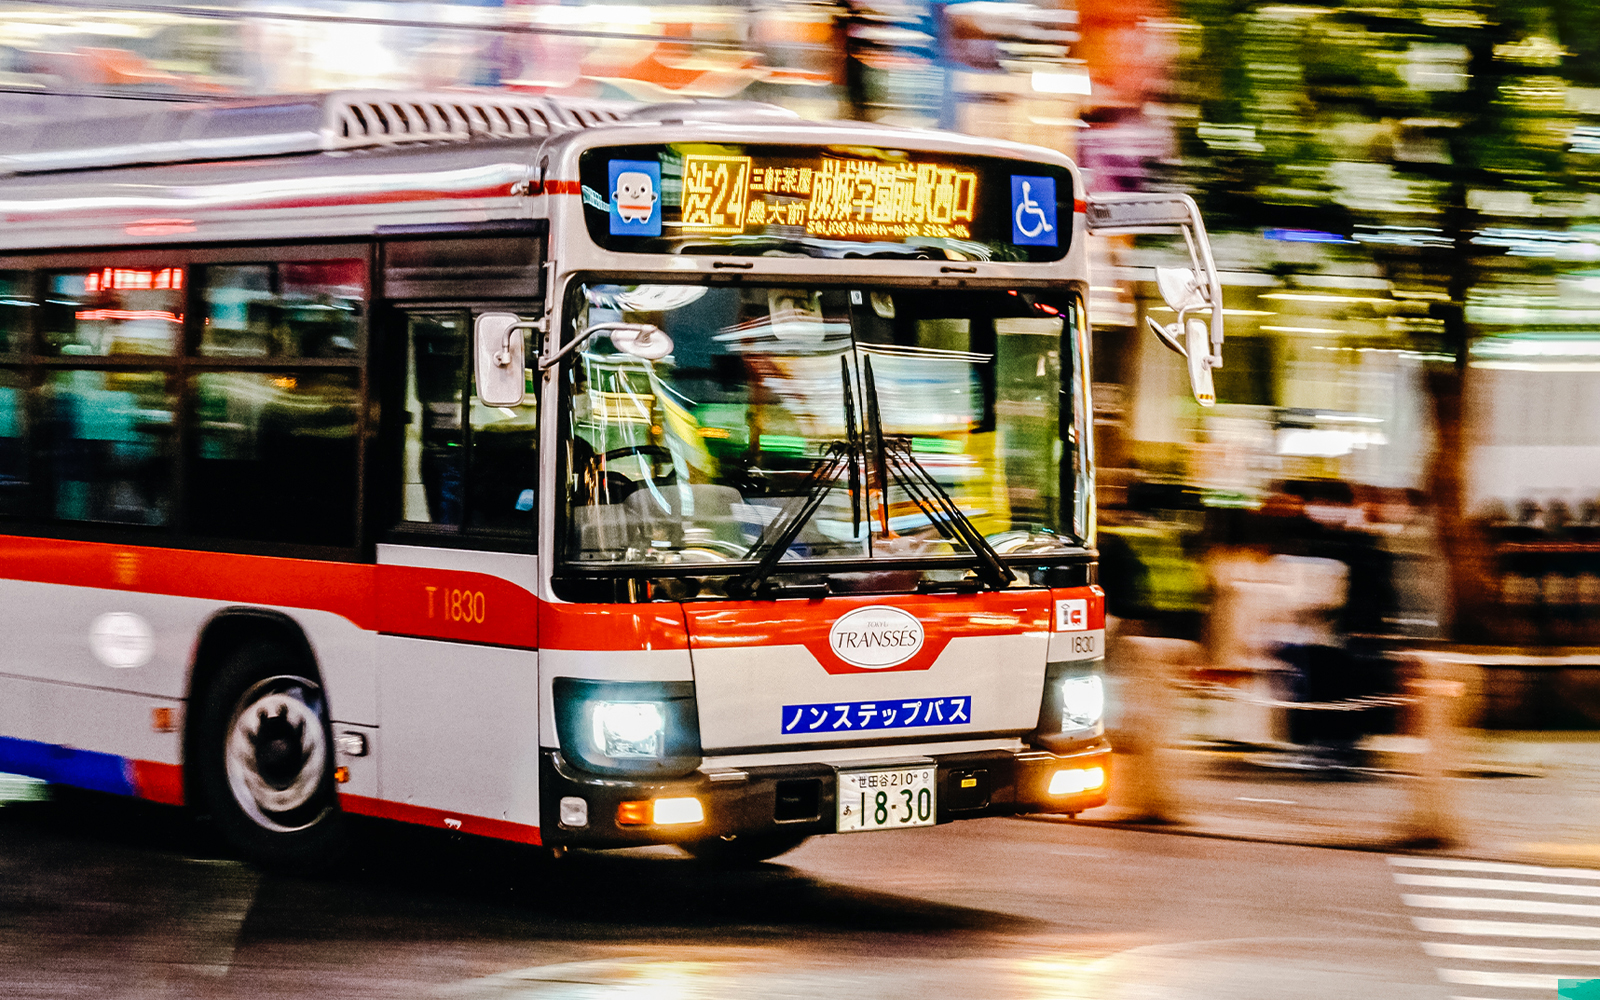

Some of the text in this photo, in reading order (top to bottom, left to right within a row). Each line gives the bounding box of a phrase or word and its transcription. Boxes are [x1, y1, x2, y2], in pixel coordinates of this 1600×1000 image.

[683, 162, 745, 225] 渋24
[808, 160, 977, 223] 成城学園前駅西口
[425, 586, 485, 624] T 1830
[837, 625, 917, 648] TRANSSÉS
[1071, 636, 1094, 653] 1830
[786, 698, 967, 731] ノンステップバス
[861, 788, 931, 826] 18-30
